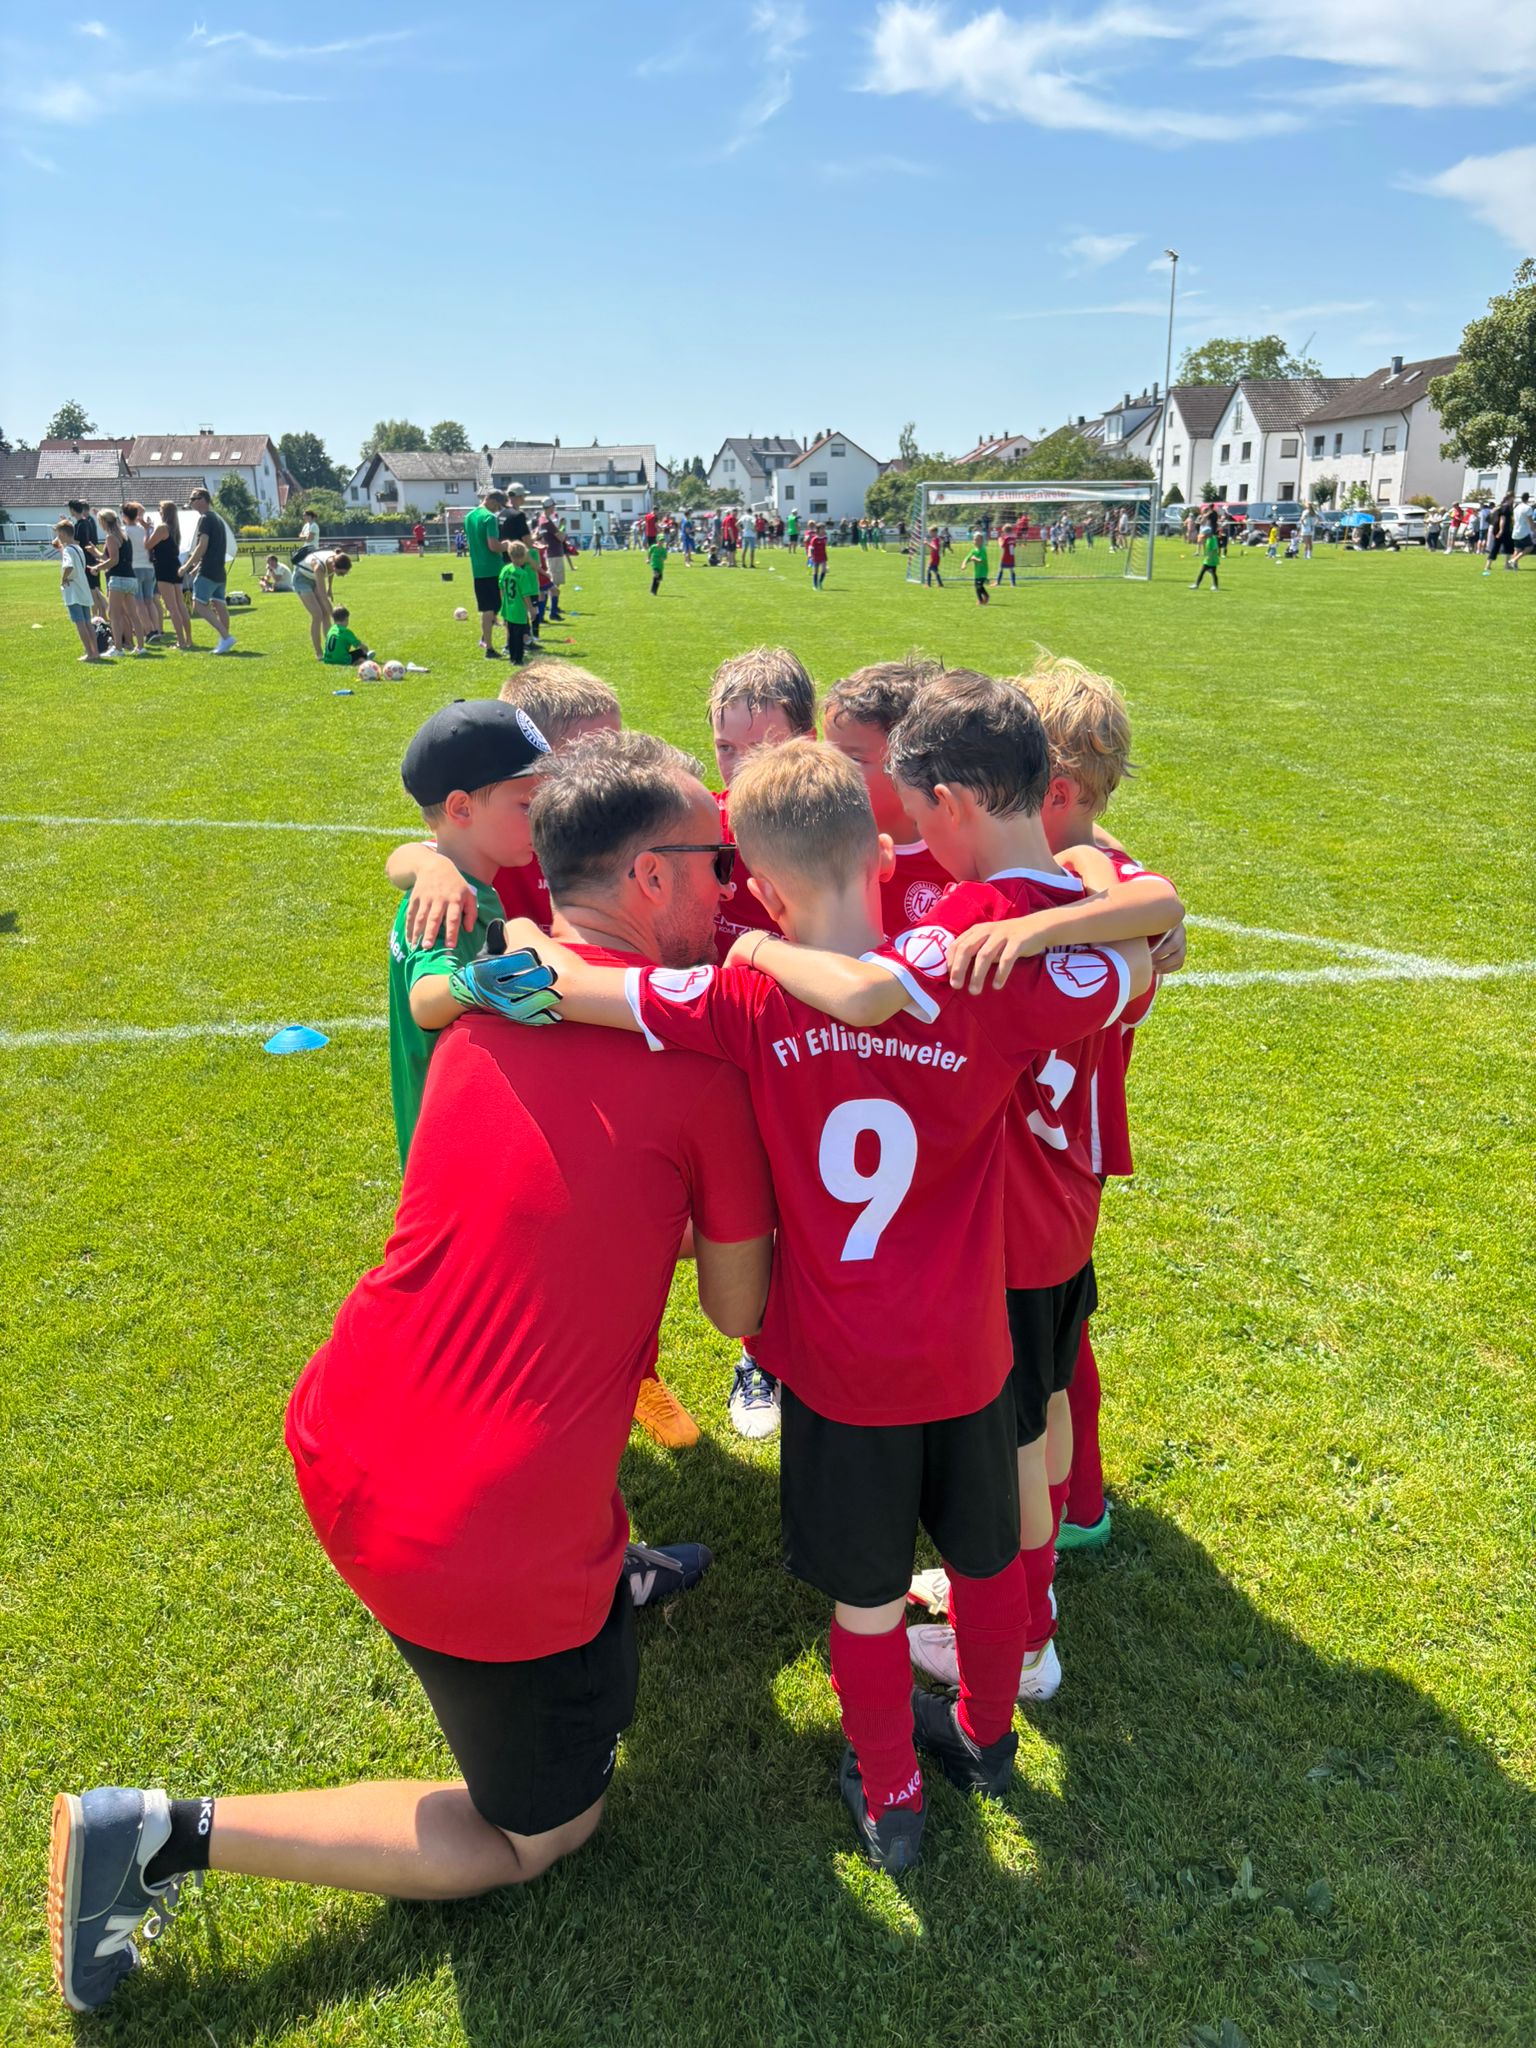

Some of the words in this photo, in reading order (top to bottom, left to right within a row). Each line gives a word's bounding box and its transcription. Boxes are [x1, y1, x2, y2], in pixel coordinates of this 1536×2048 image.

[266, 544, 300, 552] Karlsruh
[504, 577, 516, 599] 13
[772, 1036, 800, 1067] FV
[805, 1022, 968, 1072] Etlingenweier
[818, 1098, 918, 1262] 9
[629, 1569, 658, 1606] N
[883, 1770, 920, 1805] JAKO
[198, 1797, 212, 1836] KO
